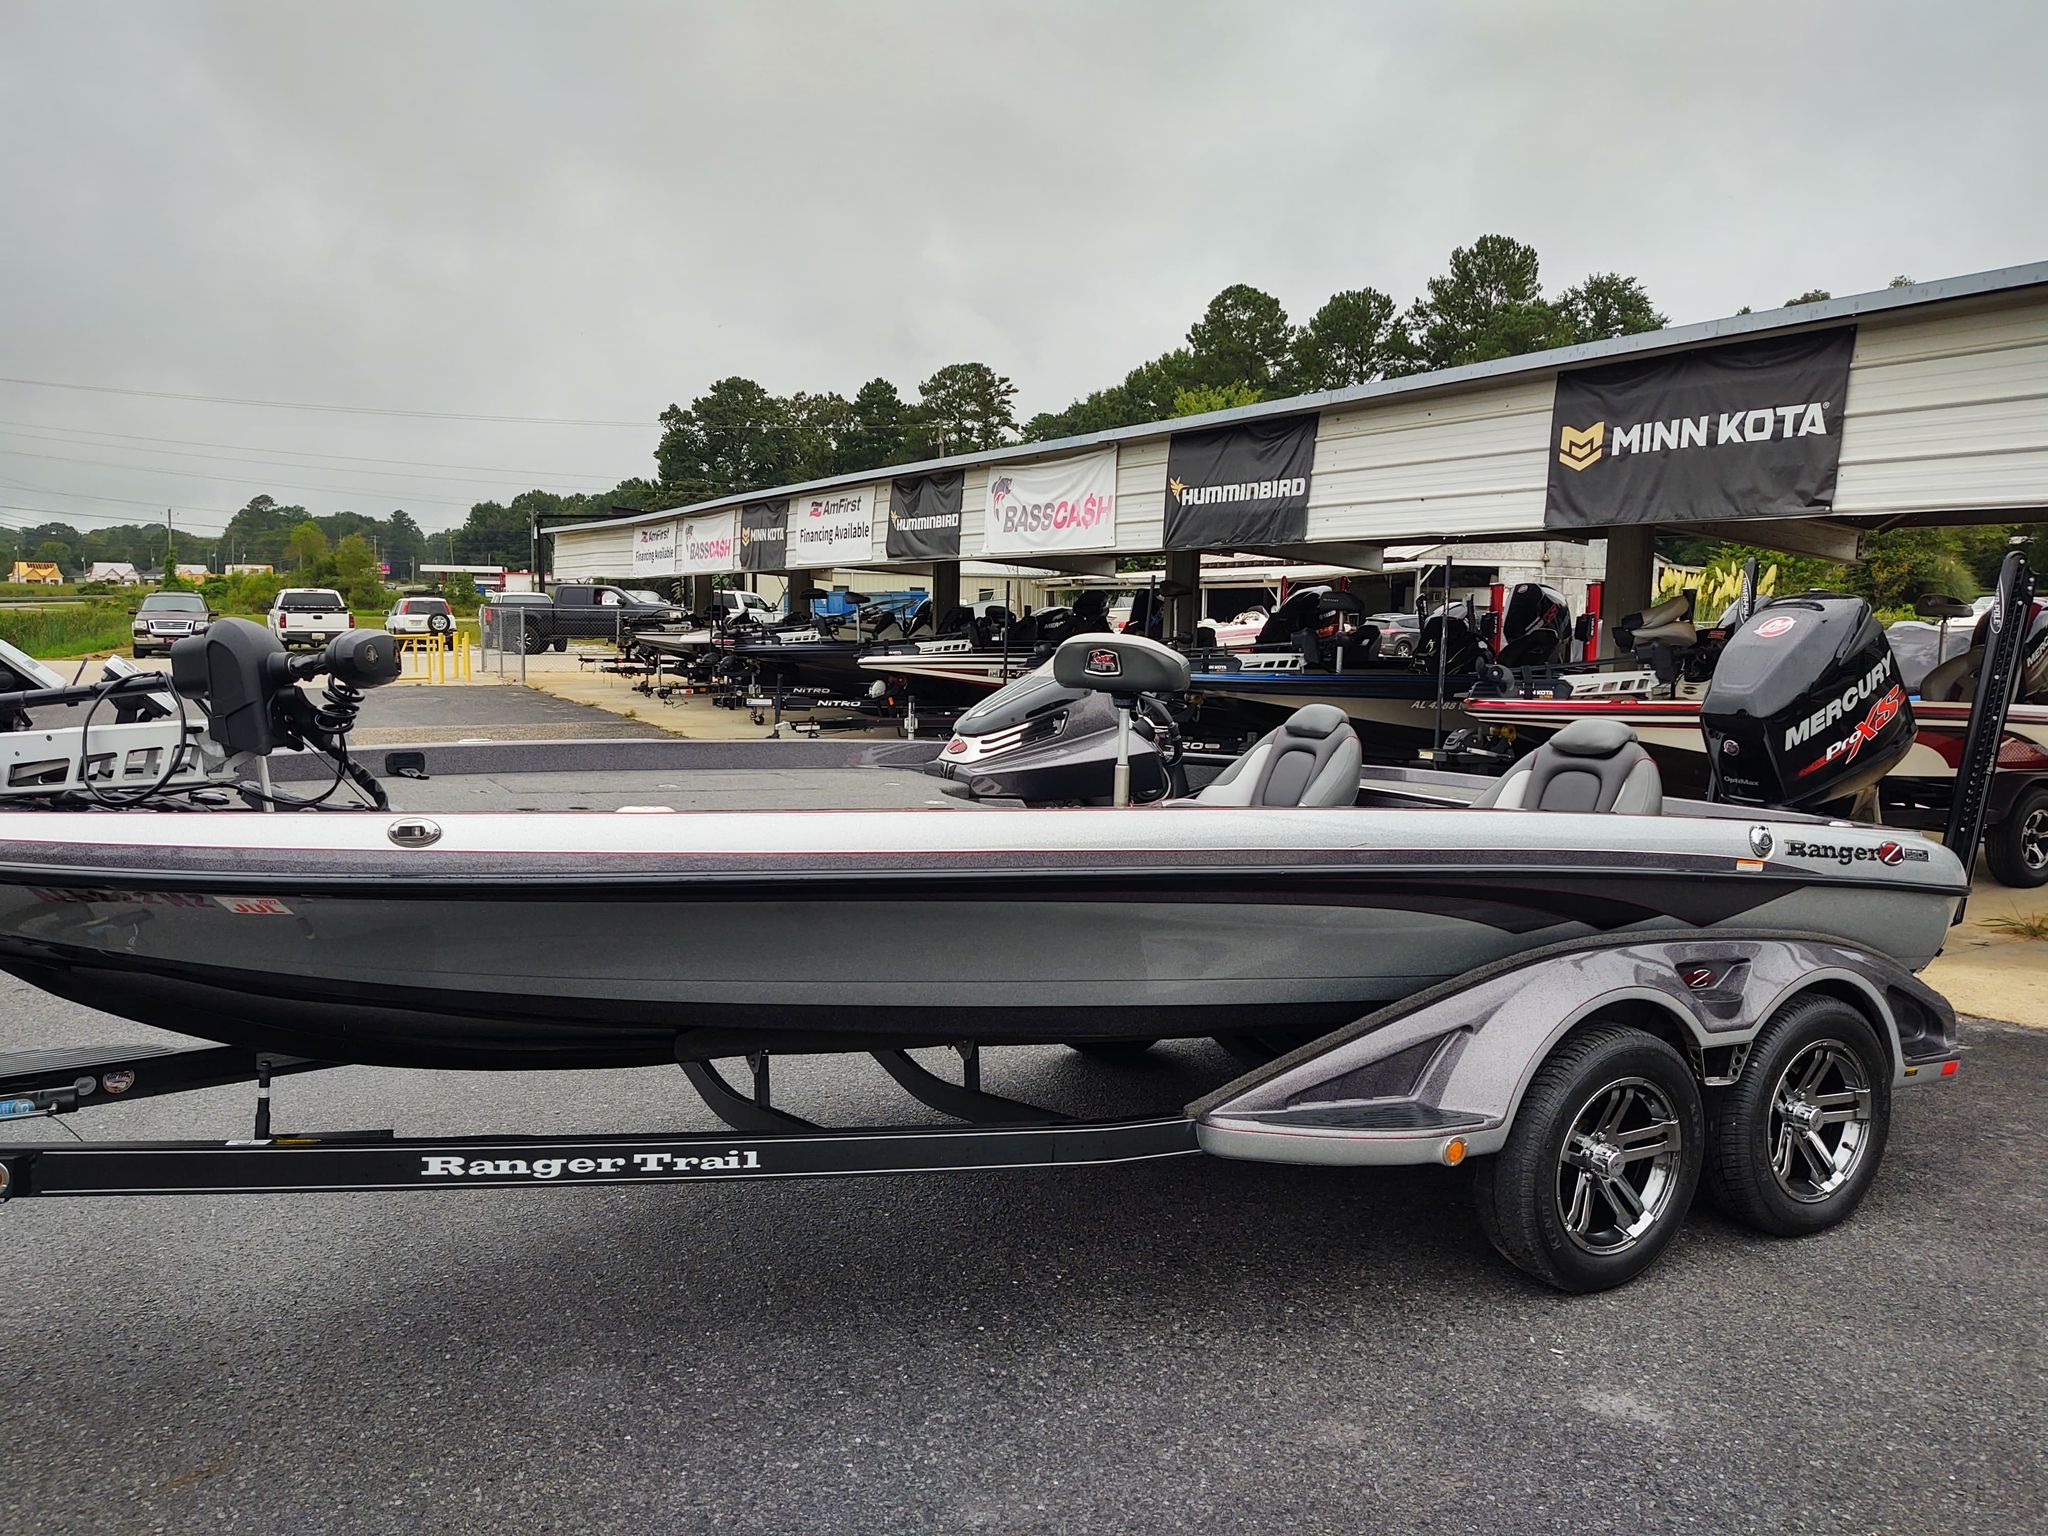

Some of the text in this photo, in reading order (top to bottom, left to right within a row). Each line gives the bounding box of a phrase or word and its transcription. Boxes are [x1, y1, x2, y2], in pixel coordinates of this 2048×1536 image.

[1611, 402, 1827, 457] MINN KOTA
[823, 495, 862, 516] AmFirst
[648, 528, 670, 542] AmFirst
[750, 527, 785, 542] MINN KOTA
[800, 521, 870, 545] Financing Available
[635, 546, 674, 564] Financing Available
[1785, 650, 1893, 751] MERCURY
[1723, 775, 1760, 787] OptiMax
[1784, 839, 1880, 866] Ranger
[234, 903, 286, 914] JUL
[420, 1150, 762, 1179] Ranger Trail
